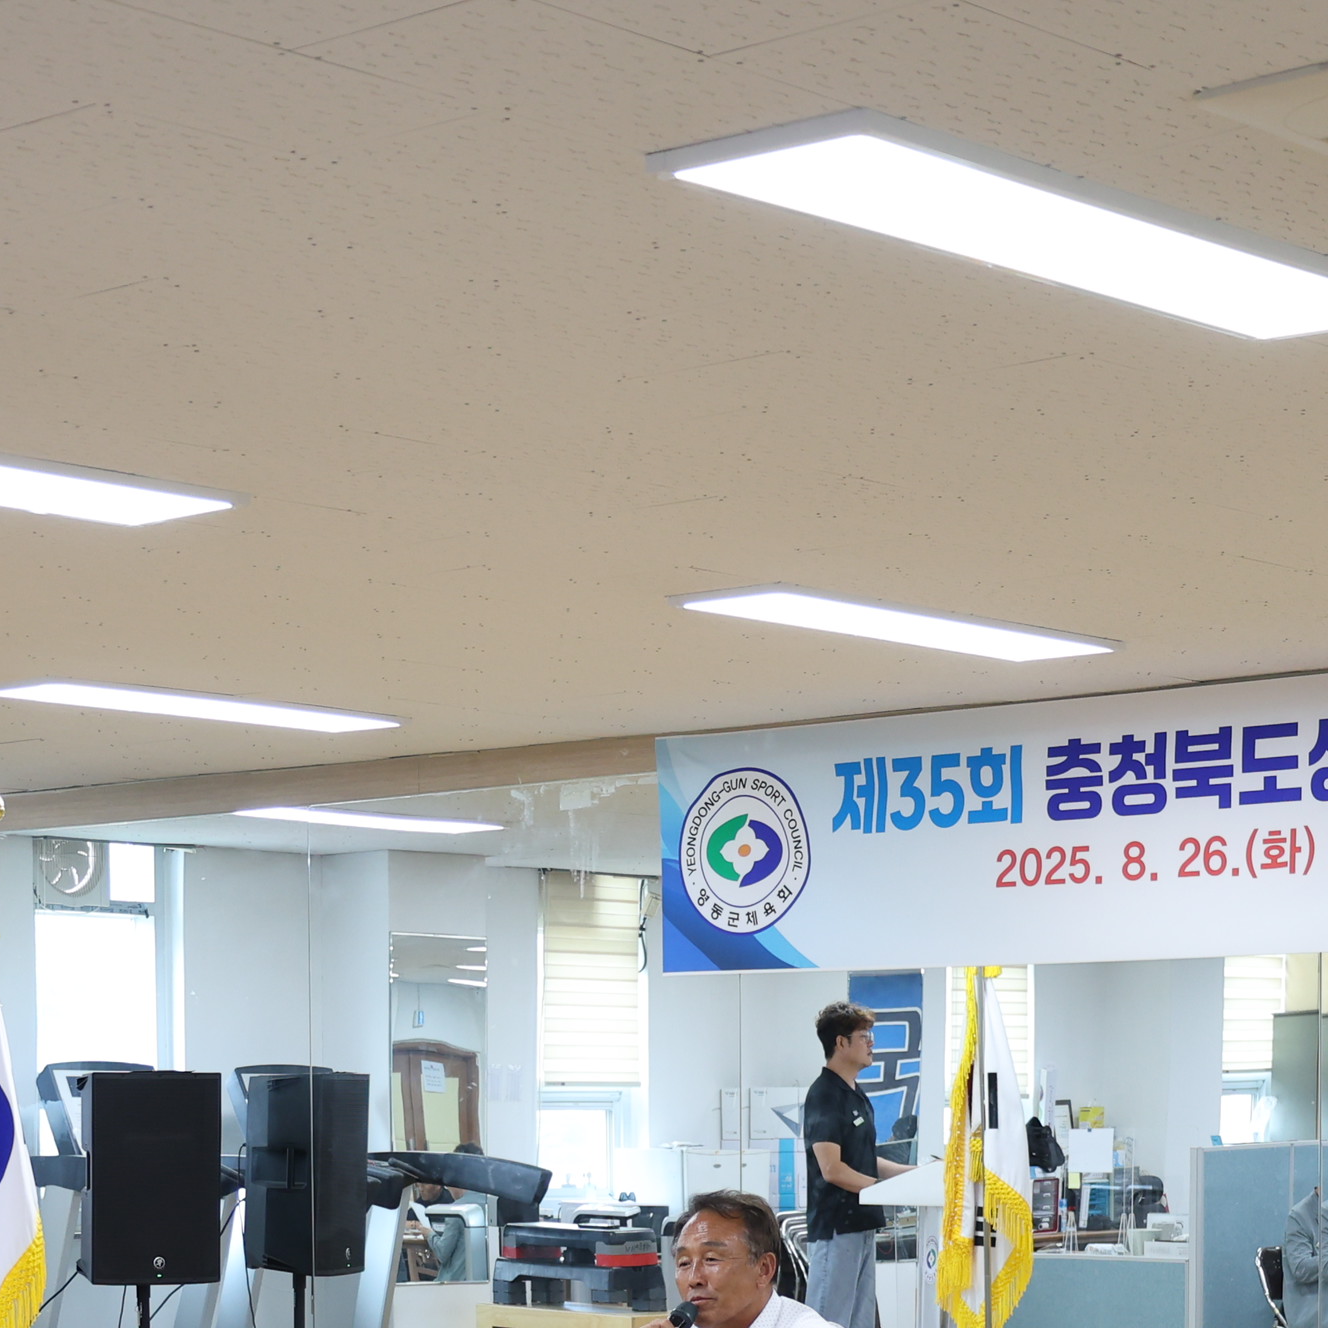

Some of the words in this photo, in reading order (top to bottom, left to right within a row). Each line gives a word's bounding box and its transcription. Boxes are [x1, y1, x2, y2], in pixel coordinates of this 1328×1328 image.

[686, 778, 748, 877] YEONGDONG-GUN
[750, 778, 787, 807] SPORT
[783, 808, 803, 872] COUNCIL
[832, 745, 1023, 834] 제35회
[995, 846, 1104, 888] 2025.
[1122, 842, 1160, 883] 8.
[1177, 824, 1316, 881] 26.(화)
[697, 885, 793, 928] 영동군체육회
